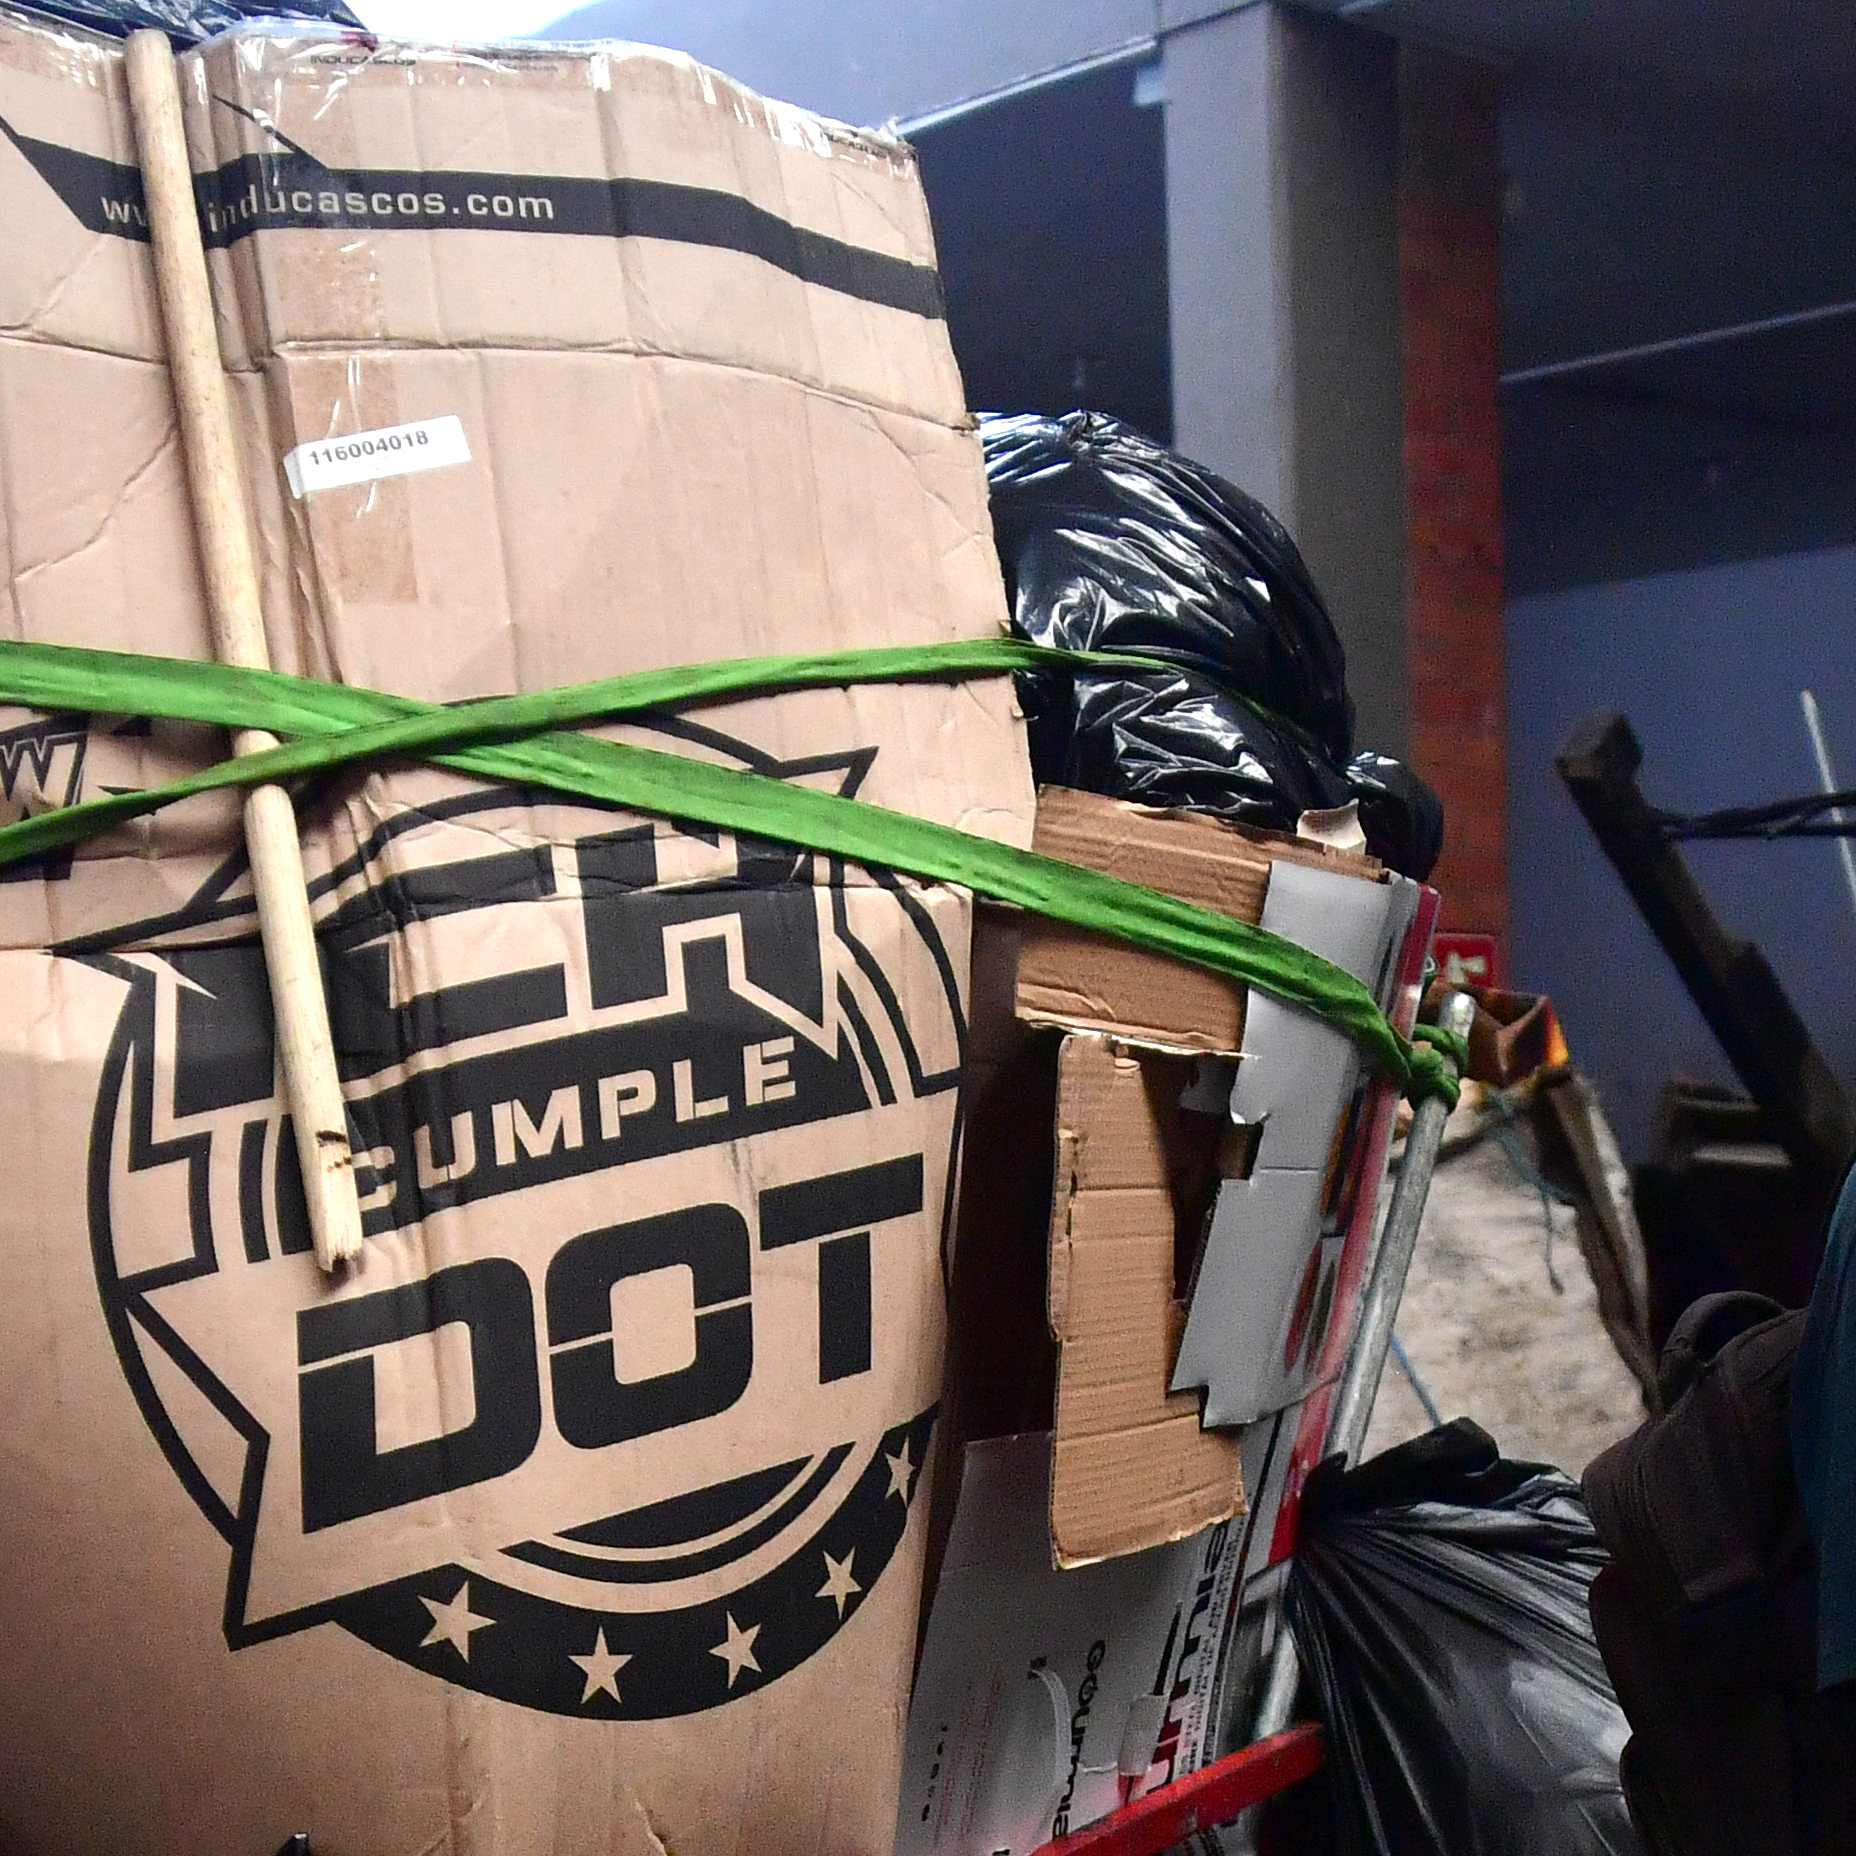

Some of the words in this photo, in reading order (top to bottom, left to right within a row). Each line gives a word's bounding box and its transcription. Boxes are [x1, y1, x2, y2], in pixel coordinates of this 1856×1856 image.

[100, 184, 555, 234] winducascos.com
[308, 430, 430, 466] 116004018
[349, 1036, 796, 1213] CUMPLE
[296, 1152, 924, 1535] DOT
